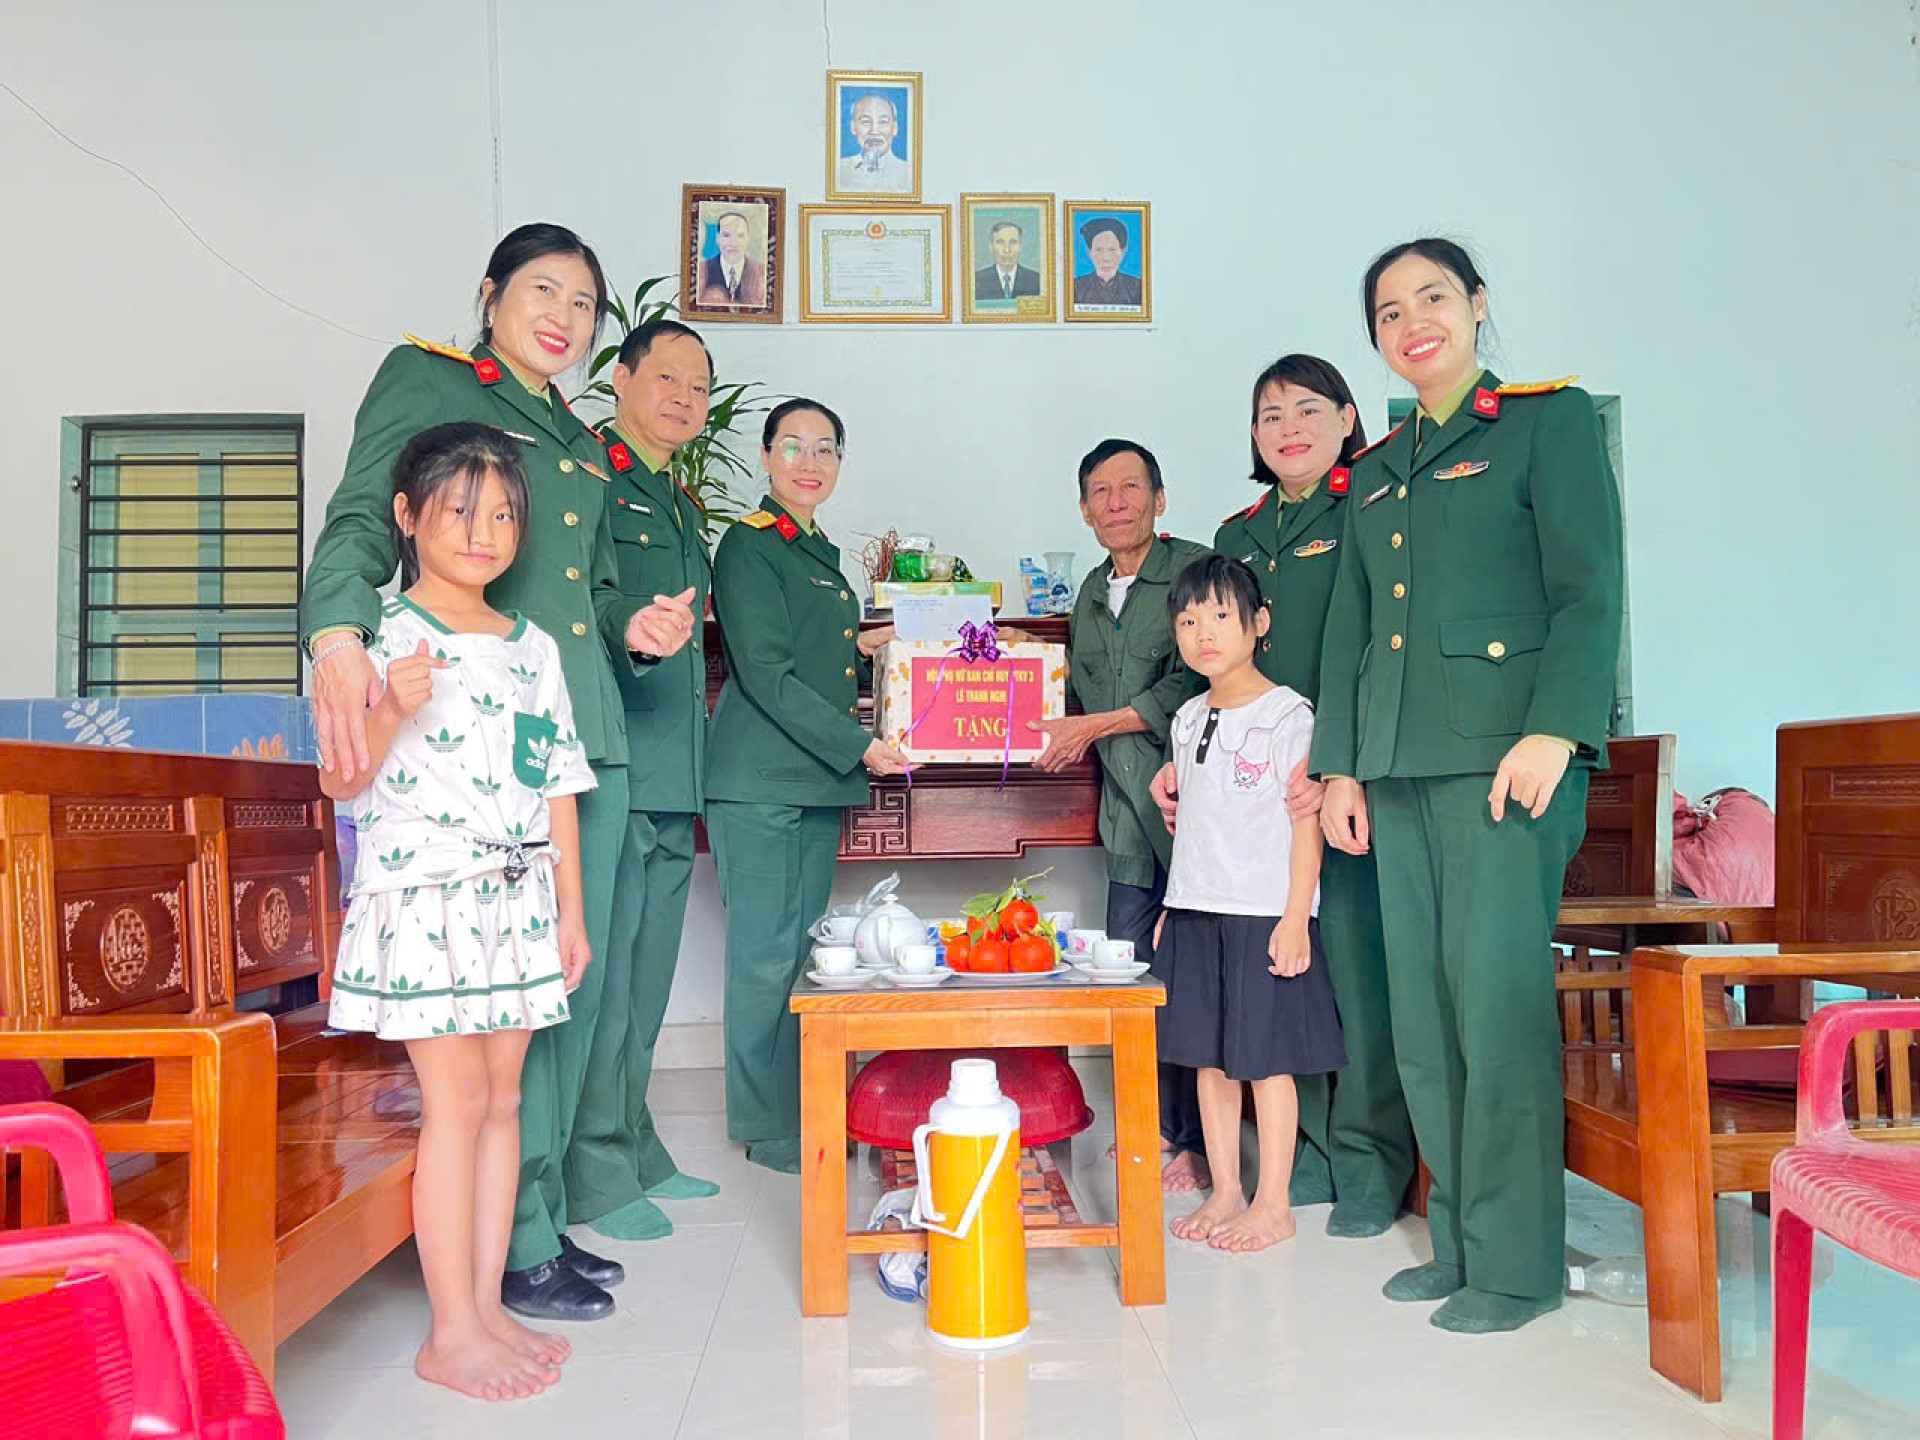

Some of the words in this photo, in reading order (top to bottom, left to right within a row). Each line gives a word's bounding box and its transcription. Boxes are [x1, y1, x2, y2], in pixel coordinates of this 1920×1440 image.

[1010, 670, 1027, 682] TKV
[966, 690, 988, 703] THANH
[954, 714, 1008, 742] TẶNG
